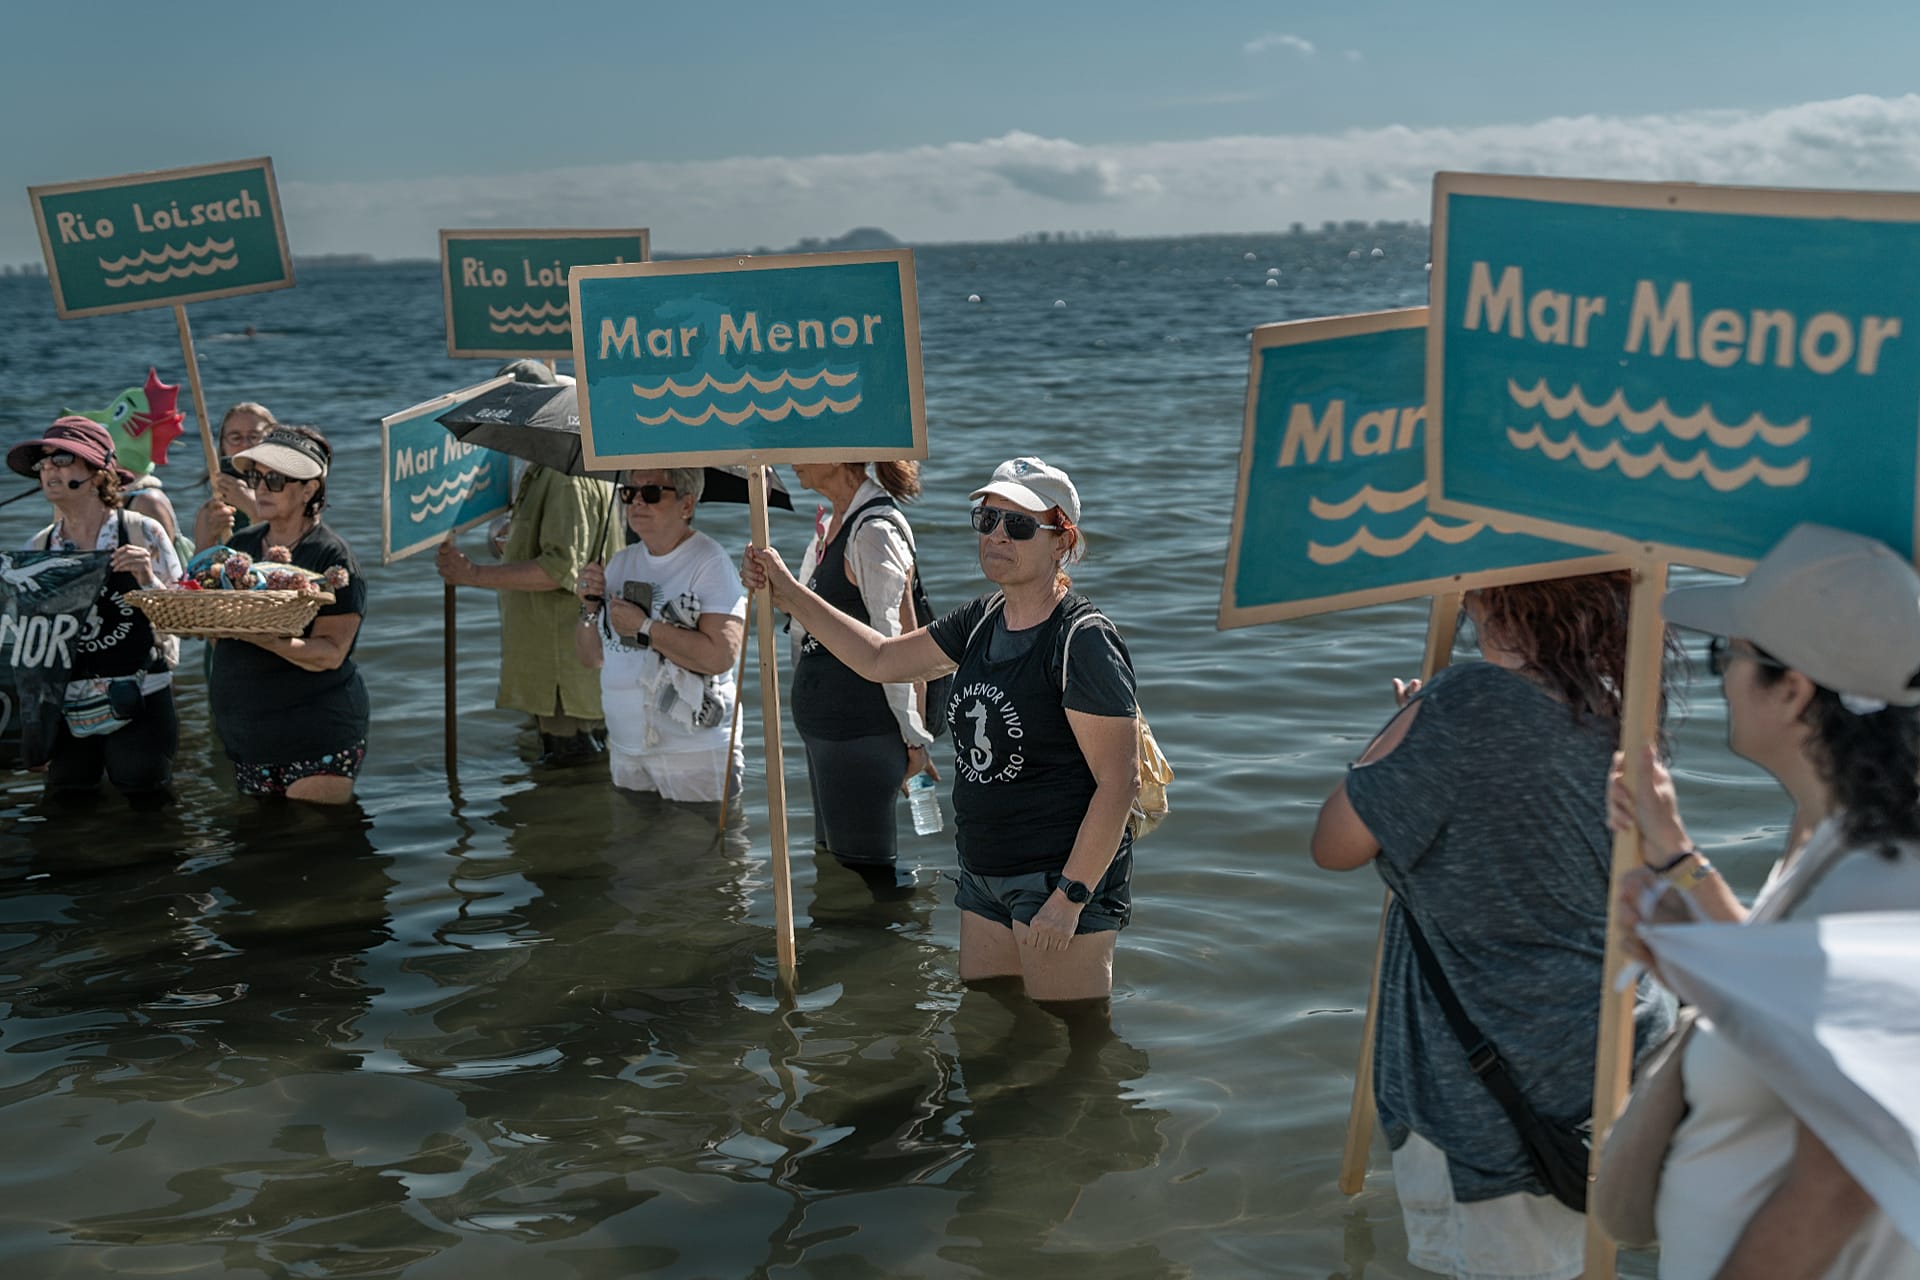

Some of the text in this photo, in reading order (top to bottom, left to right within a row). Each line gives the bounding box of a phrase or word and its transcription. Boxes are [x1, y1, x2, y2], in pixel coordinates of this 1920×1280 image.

[56, 189, 262, 244] Rio Loisach
[462, 257, 508, 288] Rio
[599, 311, 882, 360] Mar Menor
[1463, 261, 1902, 375] Mar Menor
[1277, 399, 1427, 468] Mar
[394, 446, 438, 482] Mar
[947, 682, 1025, 739] MAR MENOR VIVO
